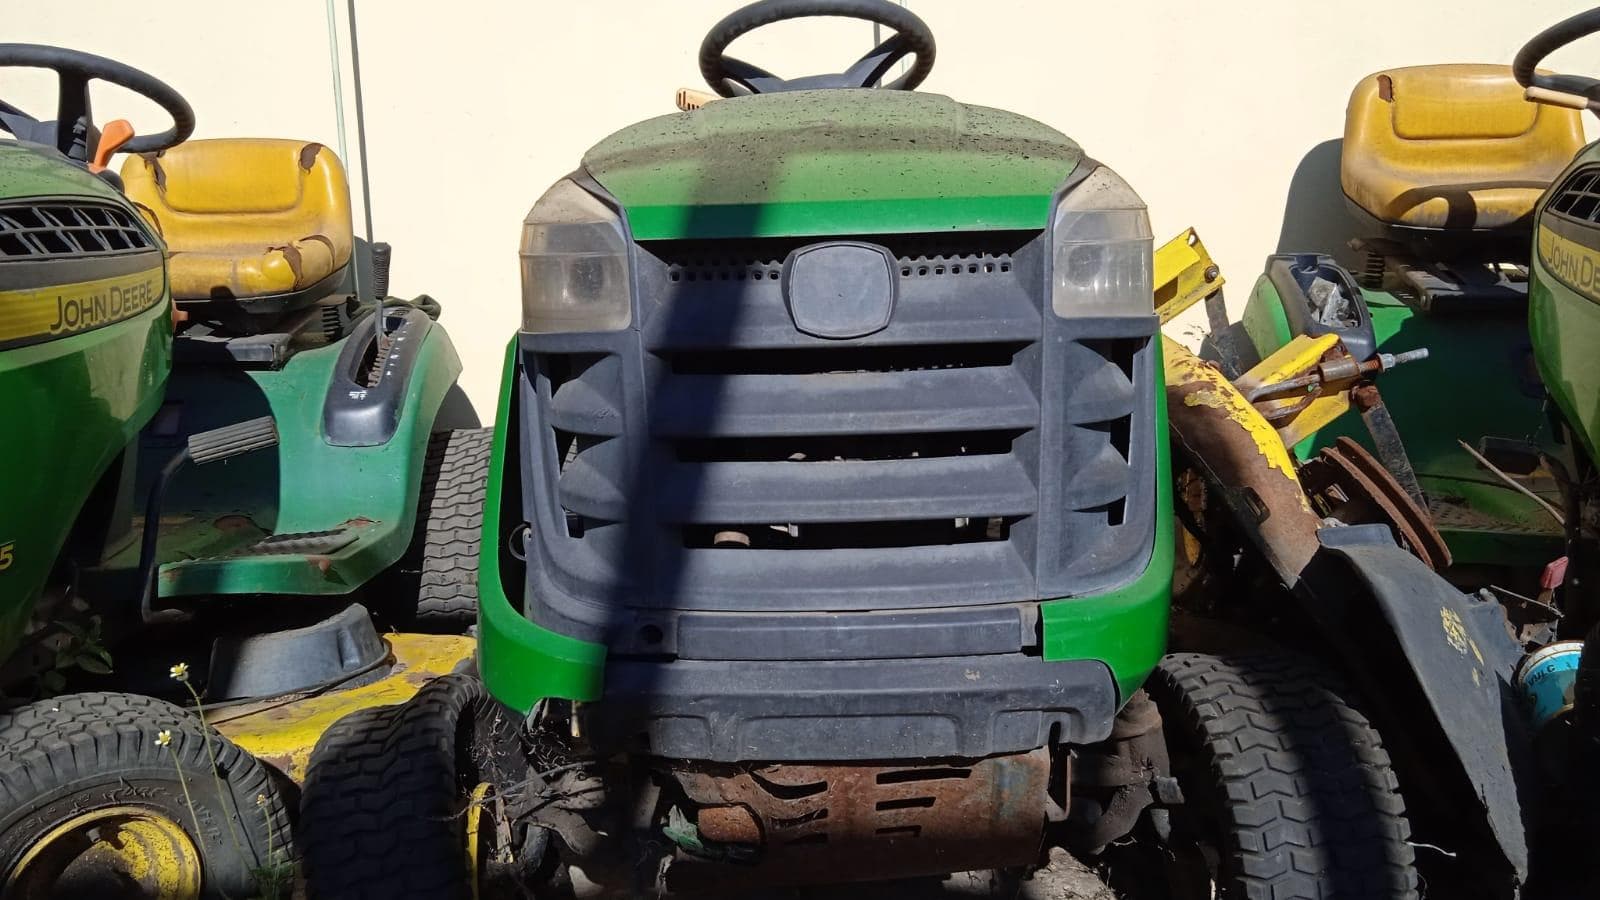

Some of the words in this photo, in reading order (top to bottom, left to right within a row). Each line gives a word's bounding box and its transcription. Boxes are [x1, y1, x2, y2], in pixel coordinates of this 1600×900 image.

[1547, 235, 1578, 282] JOHN
[50, 296, 107, 332] JOHN
[110, 279, 153, 316] DEERE
